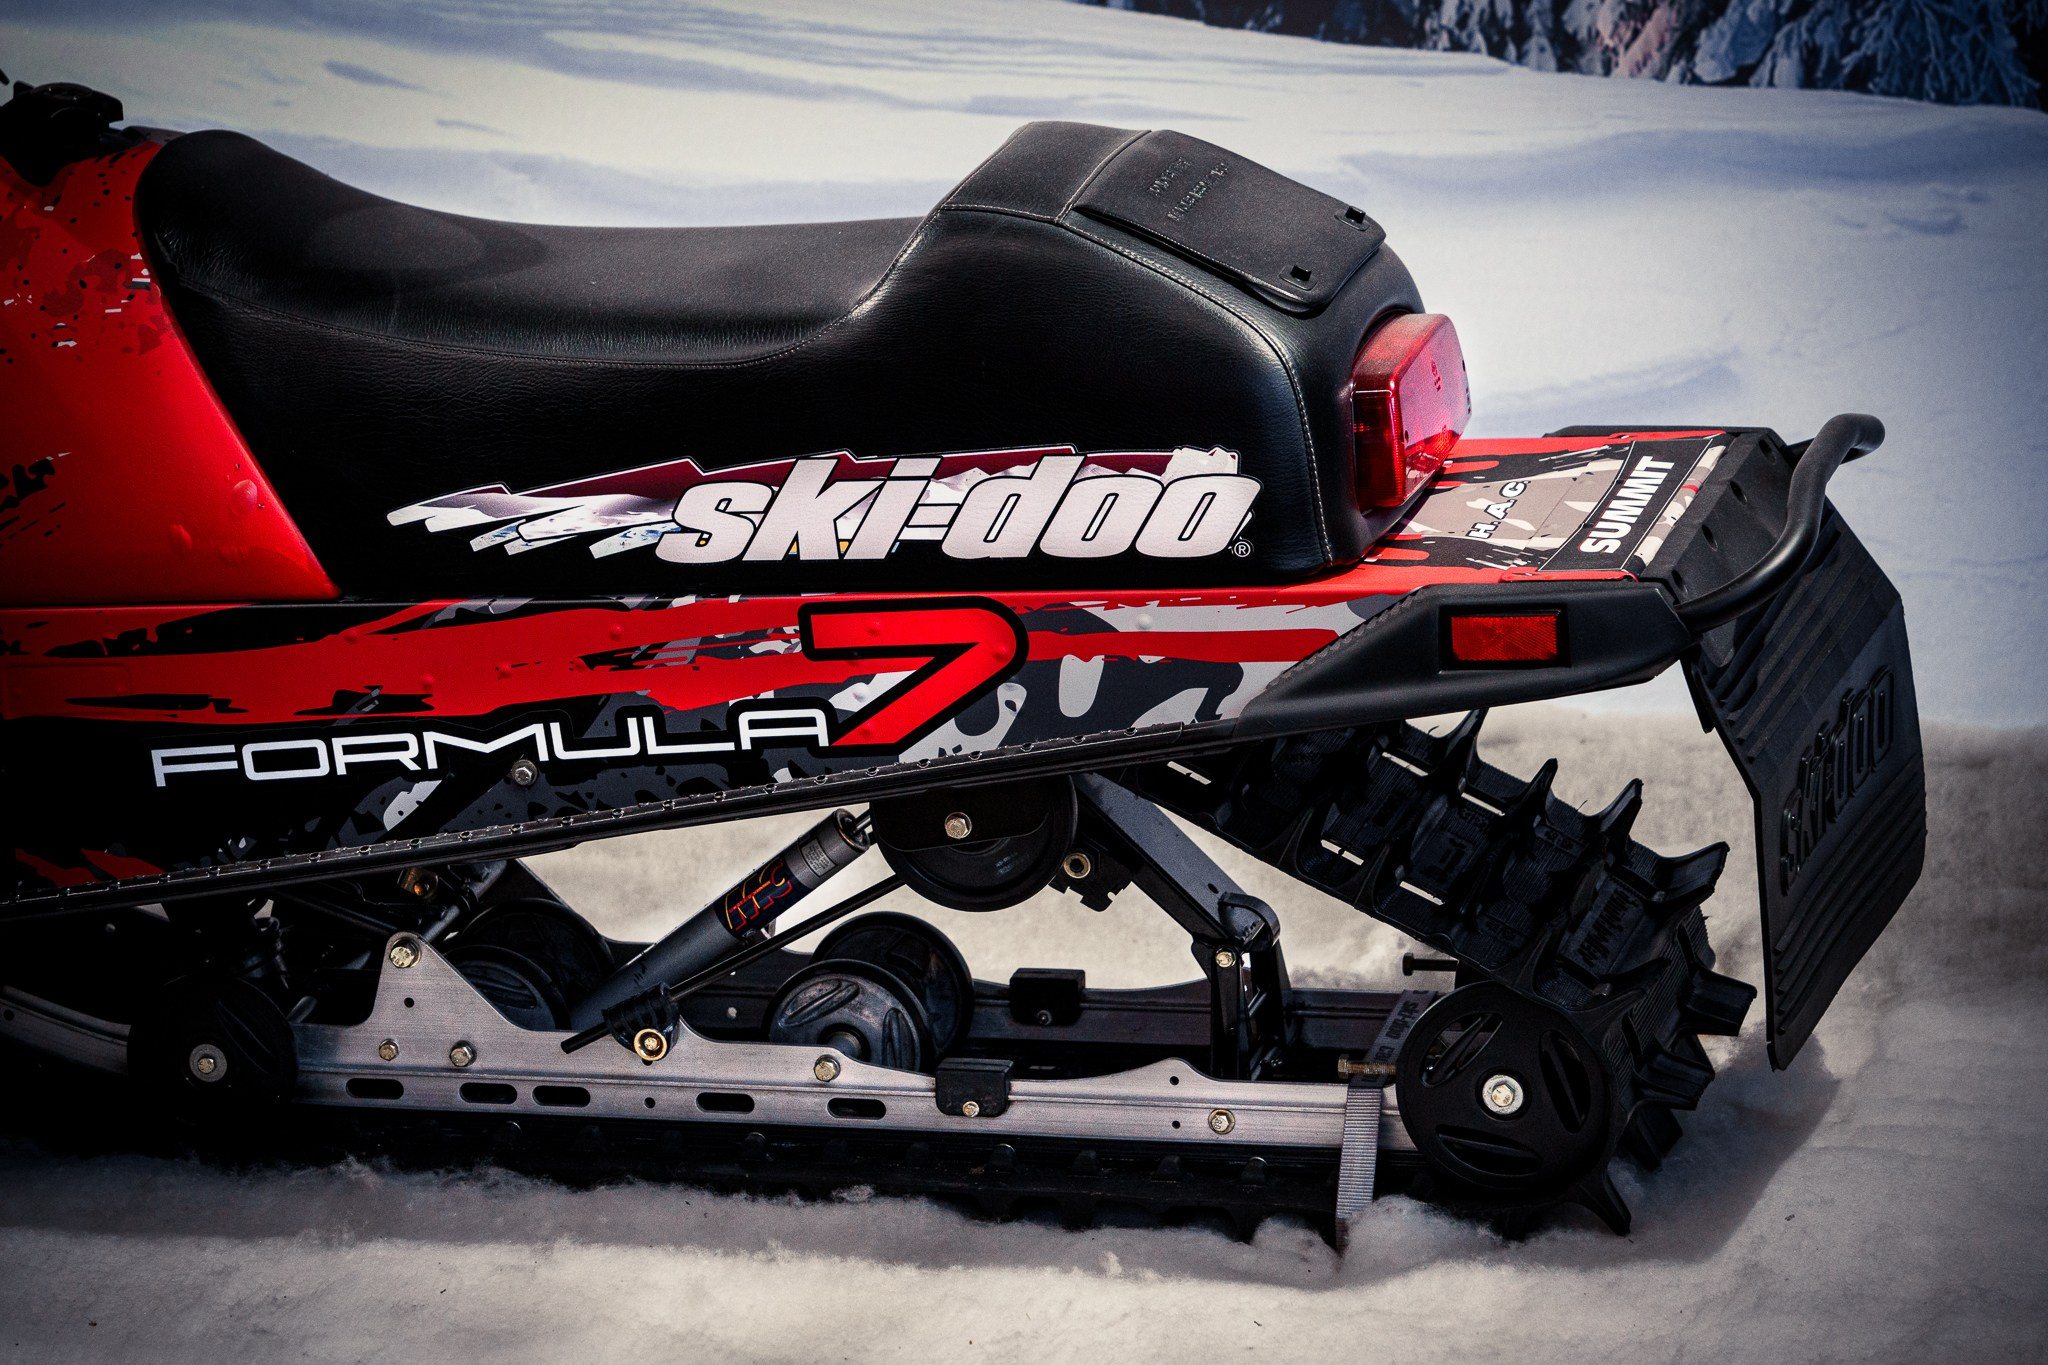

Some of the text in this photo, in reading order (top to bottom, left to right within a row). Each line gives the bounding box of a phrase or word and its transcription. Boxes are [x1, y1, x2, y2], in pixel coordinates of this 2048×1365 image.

[1579, 456, 1674, 554] SUMMIT
[151, 608, 1016, 787] FORMULA 7
